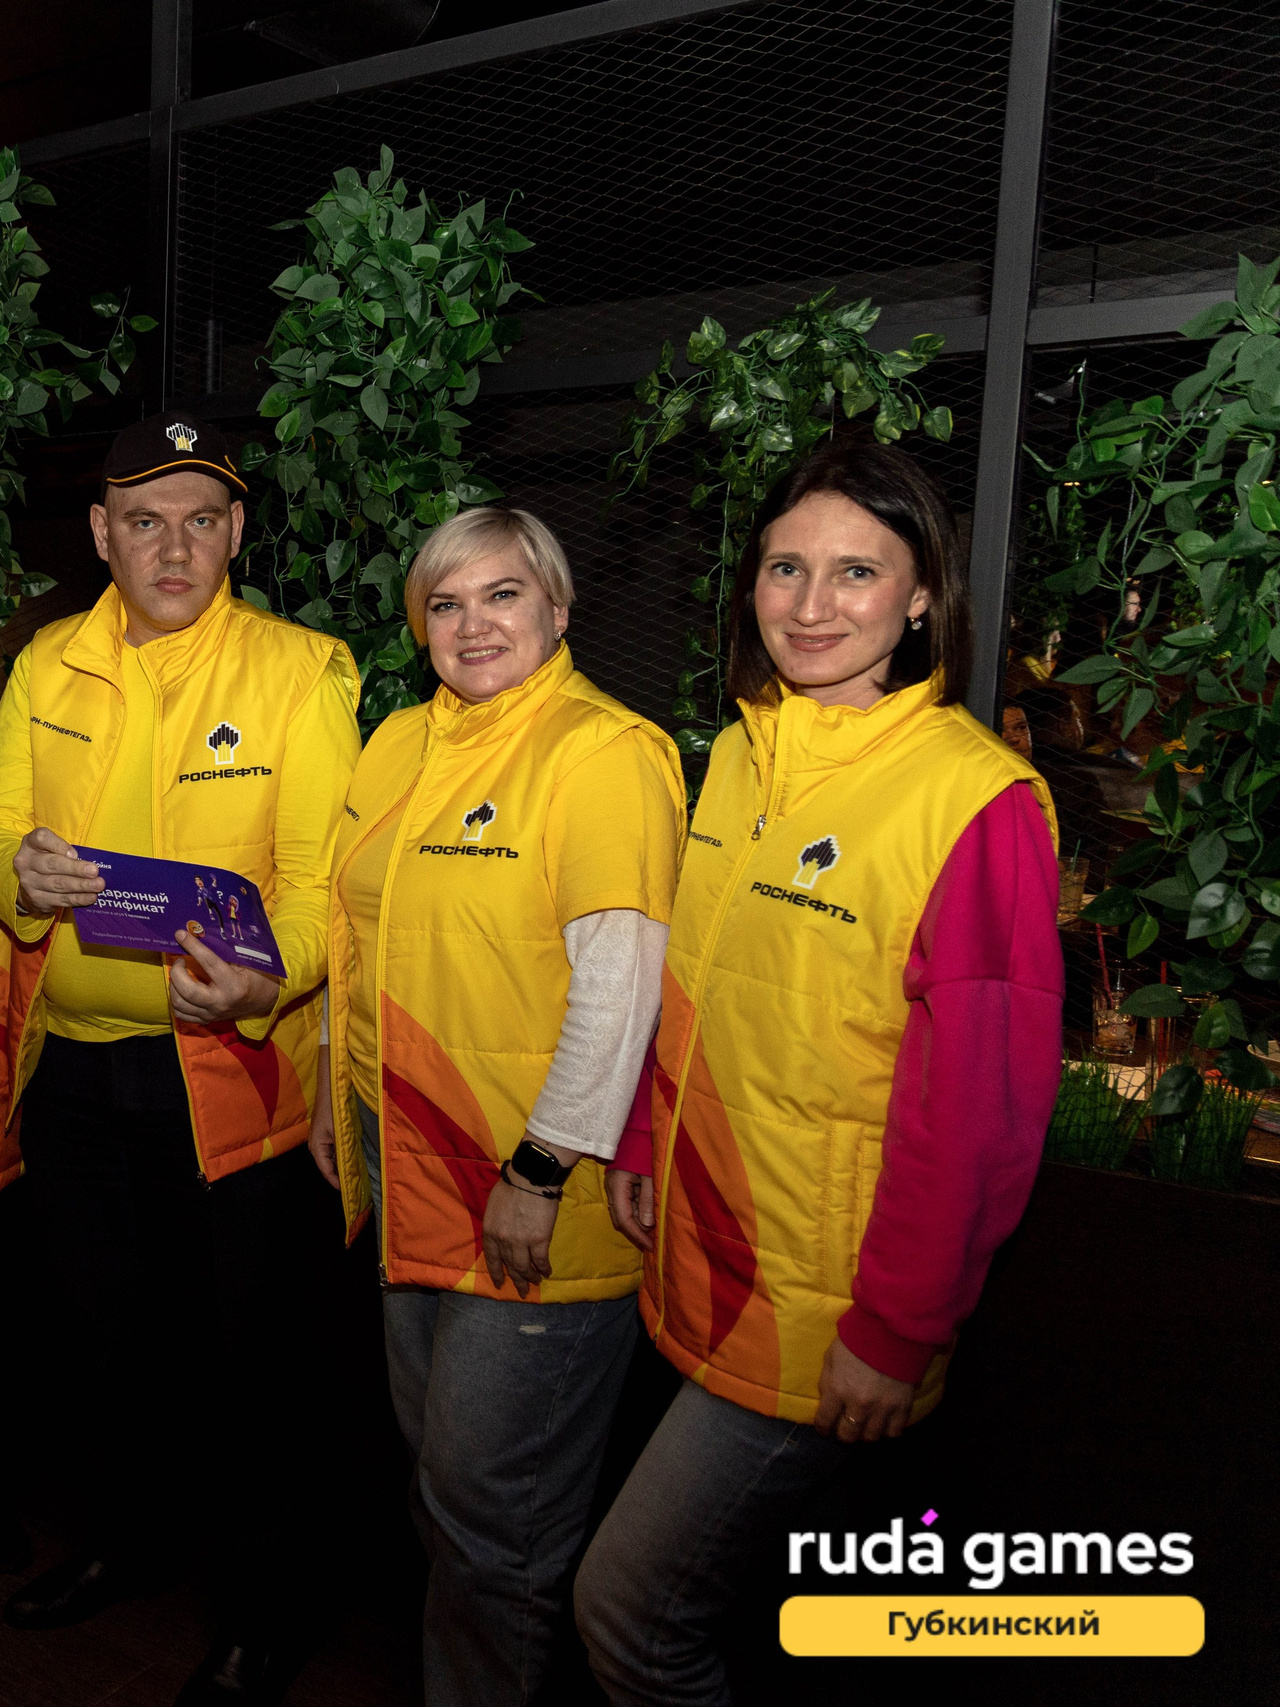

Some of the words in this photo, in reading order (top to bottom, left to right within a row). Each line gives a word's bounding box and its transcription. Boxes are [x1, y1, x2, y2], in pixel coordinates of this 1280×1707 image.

[179, 766, 272, 784] РОСНЕФТЬ
[419, 845, 519, 859] РОСНЕФТЬ
[94, 898, 165, 914] ртификат
[750, 881, 858, 924] РОСНЕФТЬ
